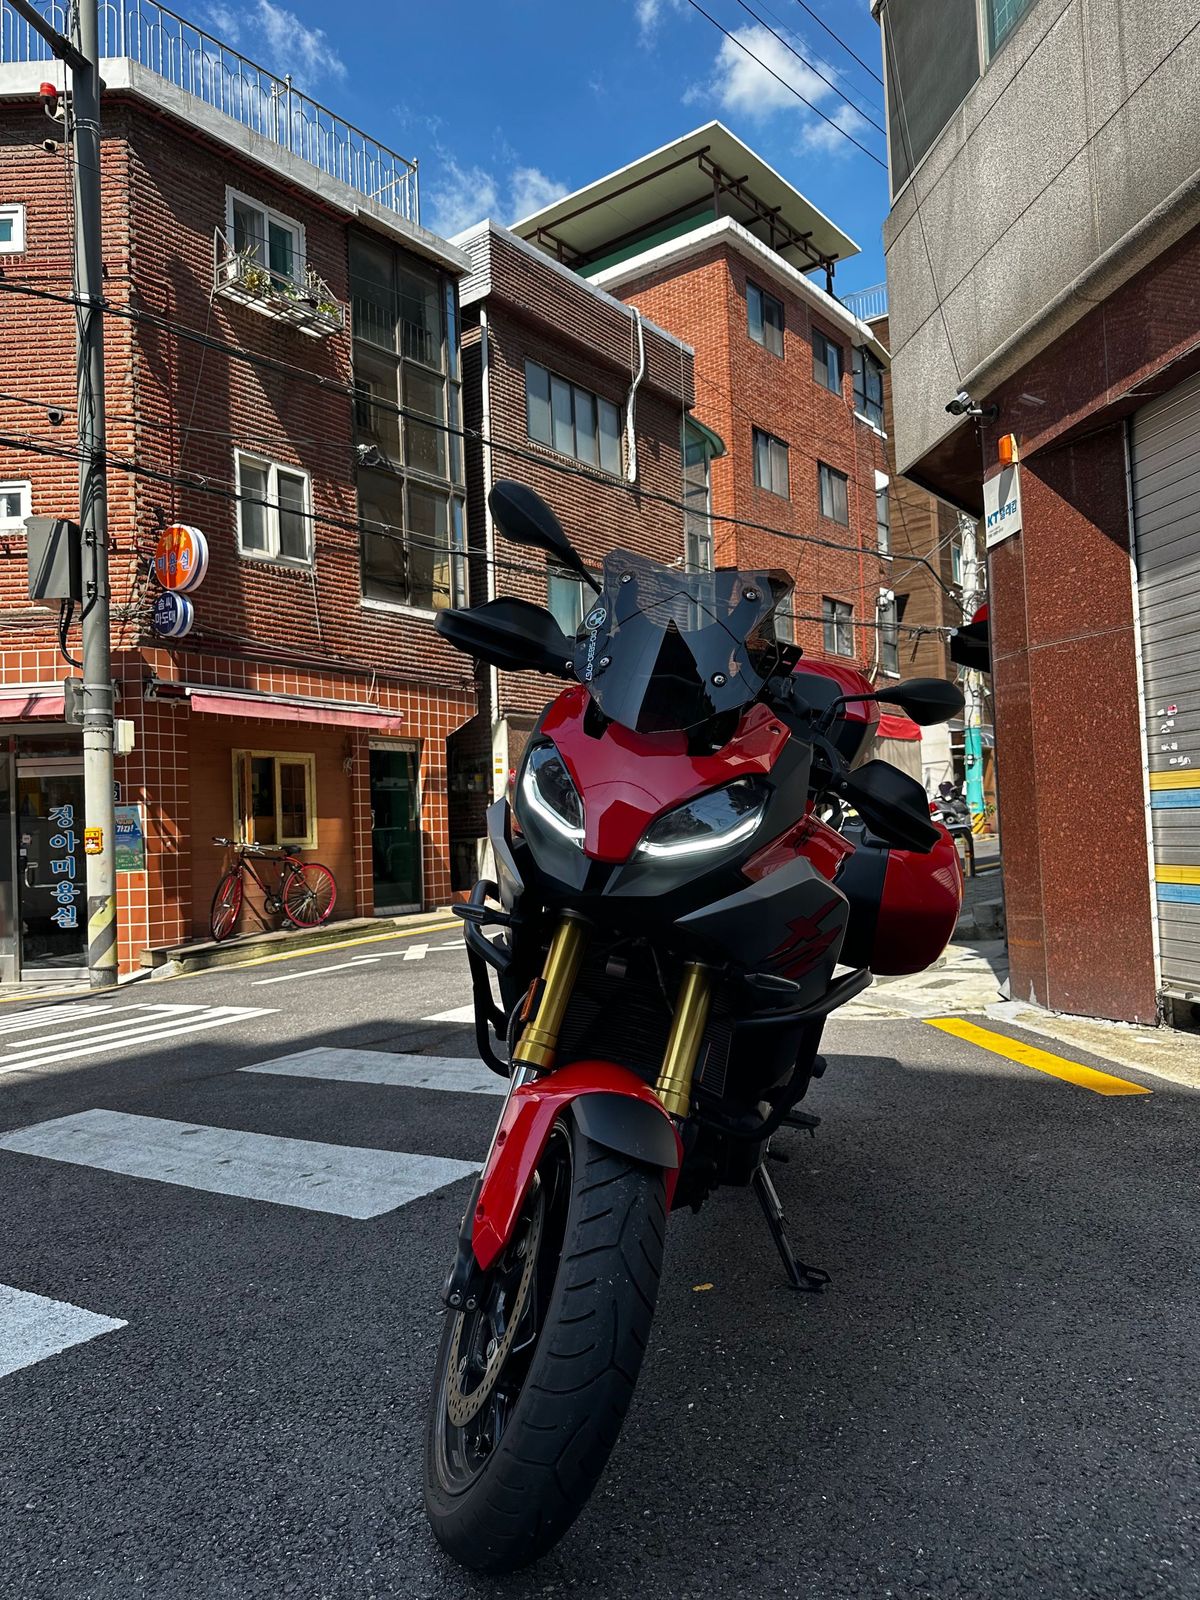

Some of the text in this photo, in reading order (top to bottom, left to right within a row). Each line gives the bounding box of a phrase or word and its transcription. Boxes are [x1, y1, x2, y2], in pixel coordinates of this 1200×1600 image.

[157, 548, 192, 576] 미용실
[116, 824, 135, 833] 가자!
[48, 804, 80, 928] 정아미용실
